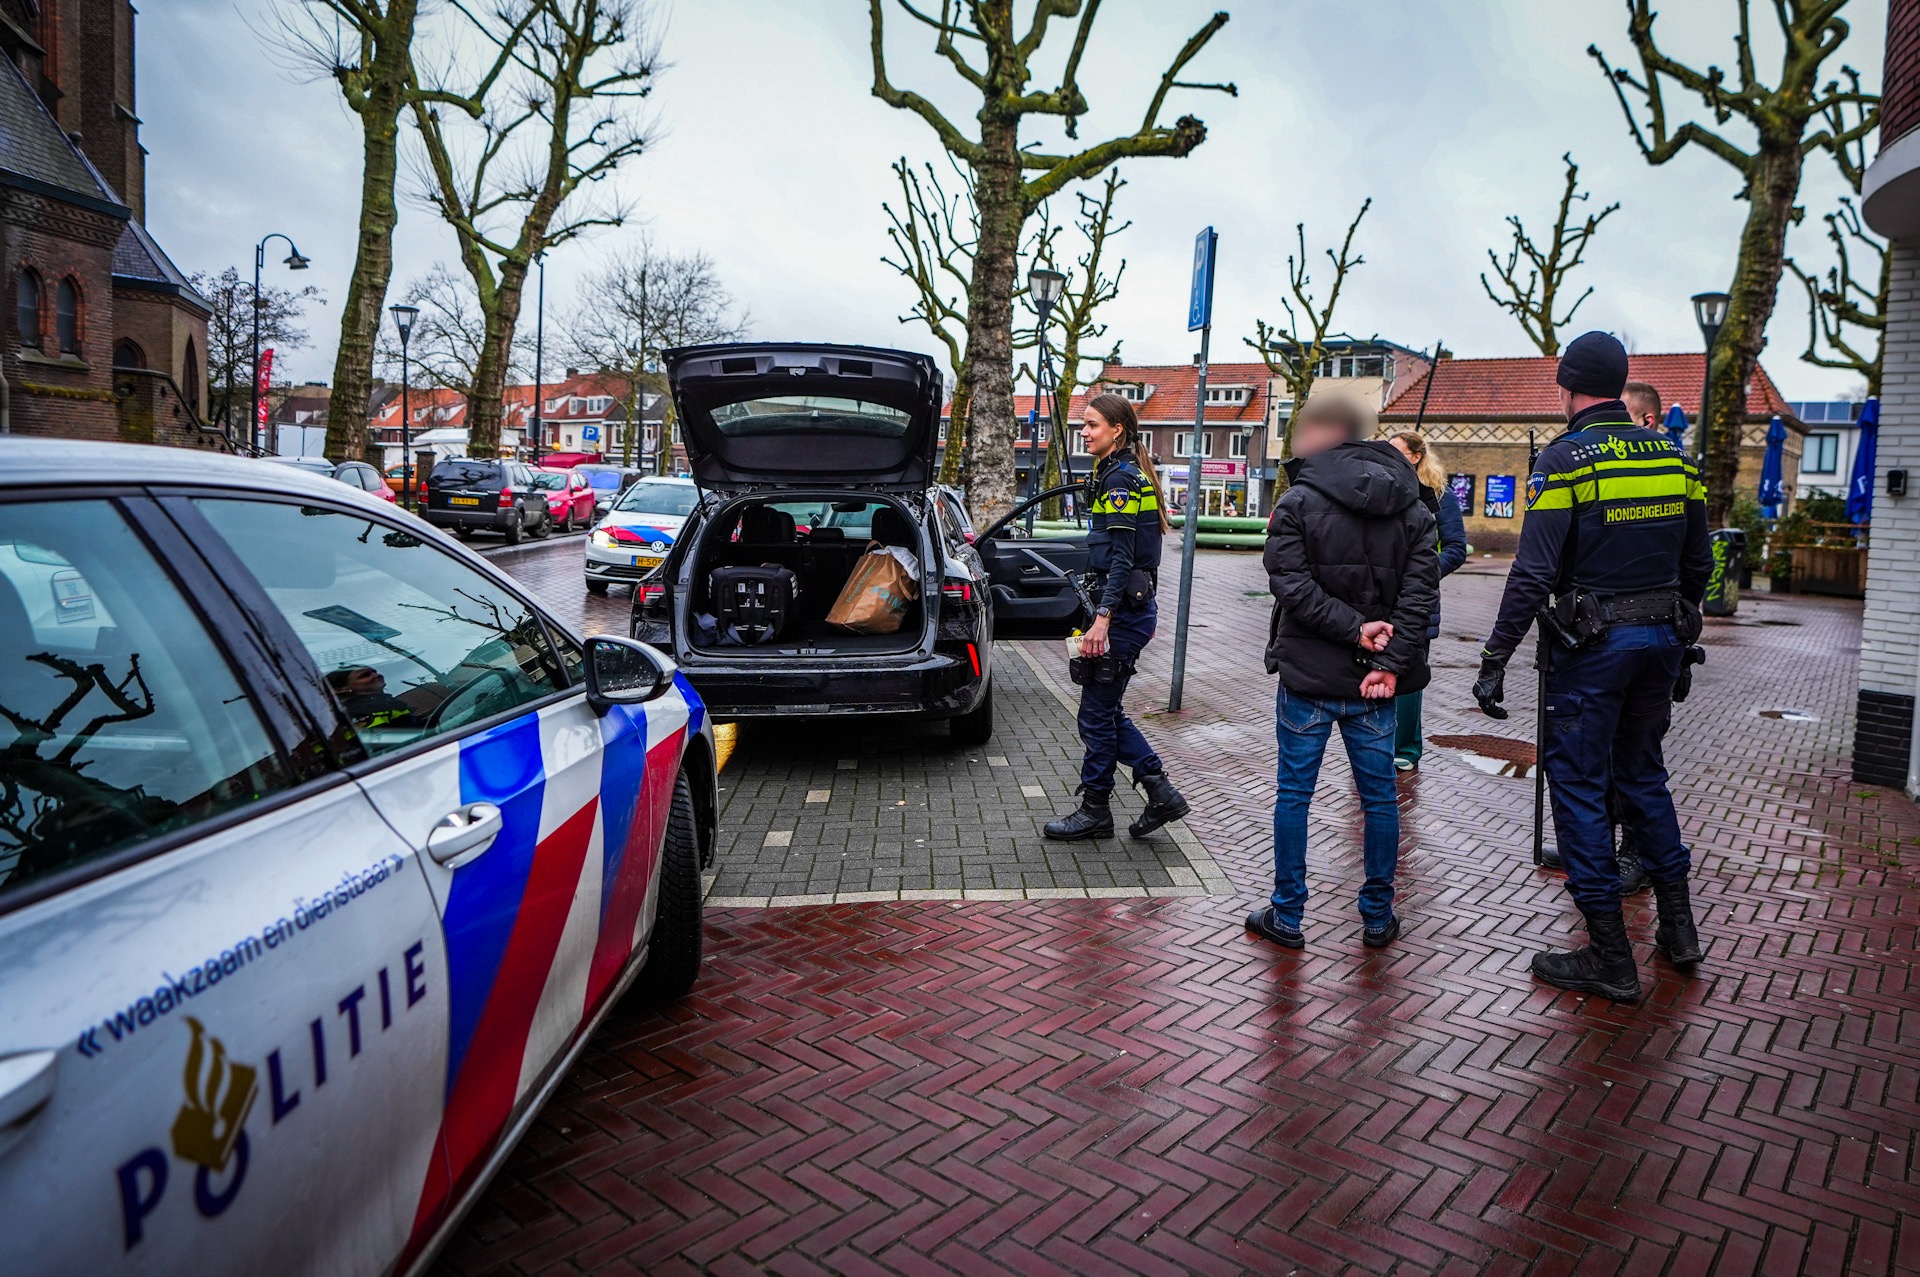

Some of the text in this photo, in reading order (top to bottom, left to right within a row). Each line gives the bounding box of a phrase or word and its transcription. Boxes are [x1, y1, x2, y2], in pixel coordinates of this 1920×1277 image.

[585, 427, 596, 439] P
[1598, 436, 1671, 459] POLITIE
[1606, 501, 1685, 522] HONDENGELEIDER
[104, 935, 263, 1042] waakzaam
[262, 917, 294, 951] en
[293, 857, 391, 931] dienstbaar
[116, 939, 428, 1254] POLITIE
